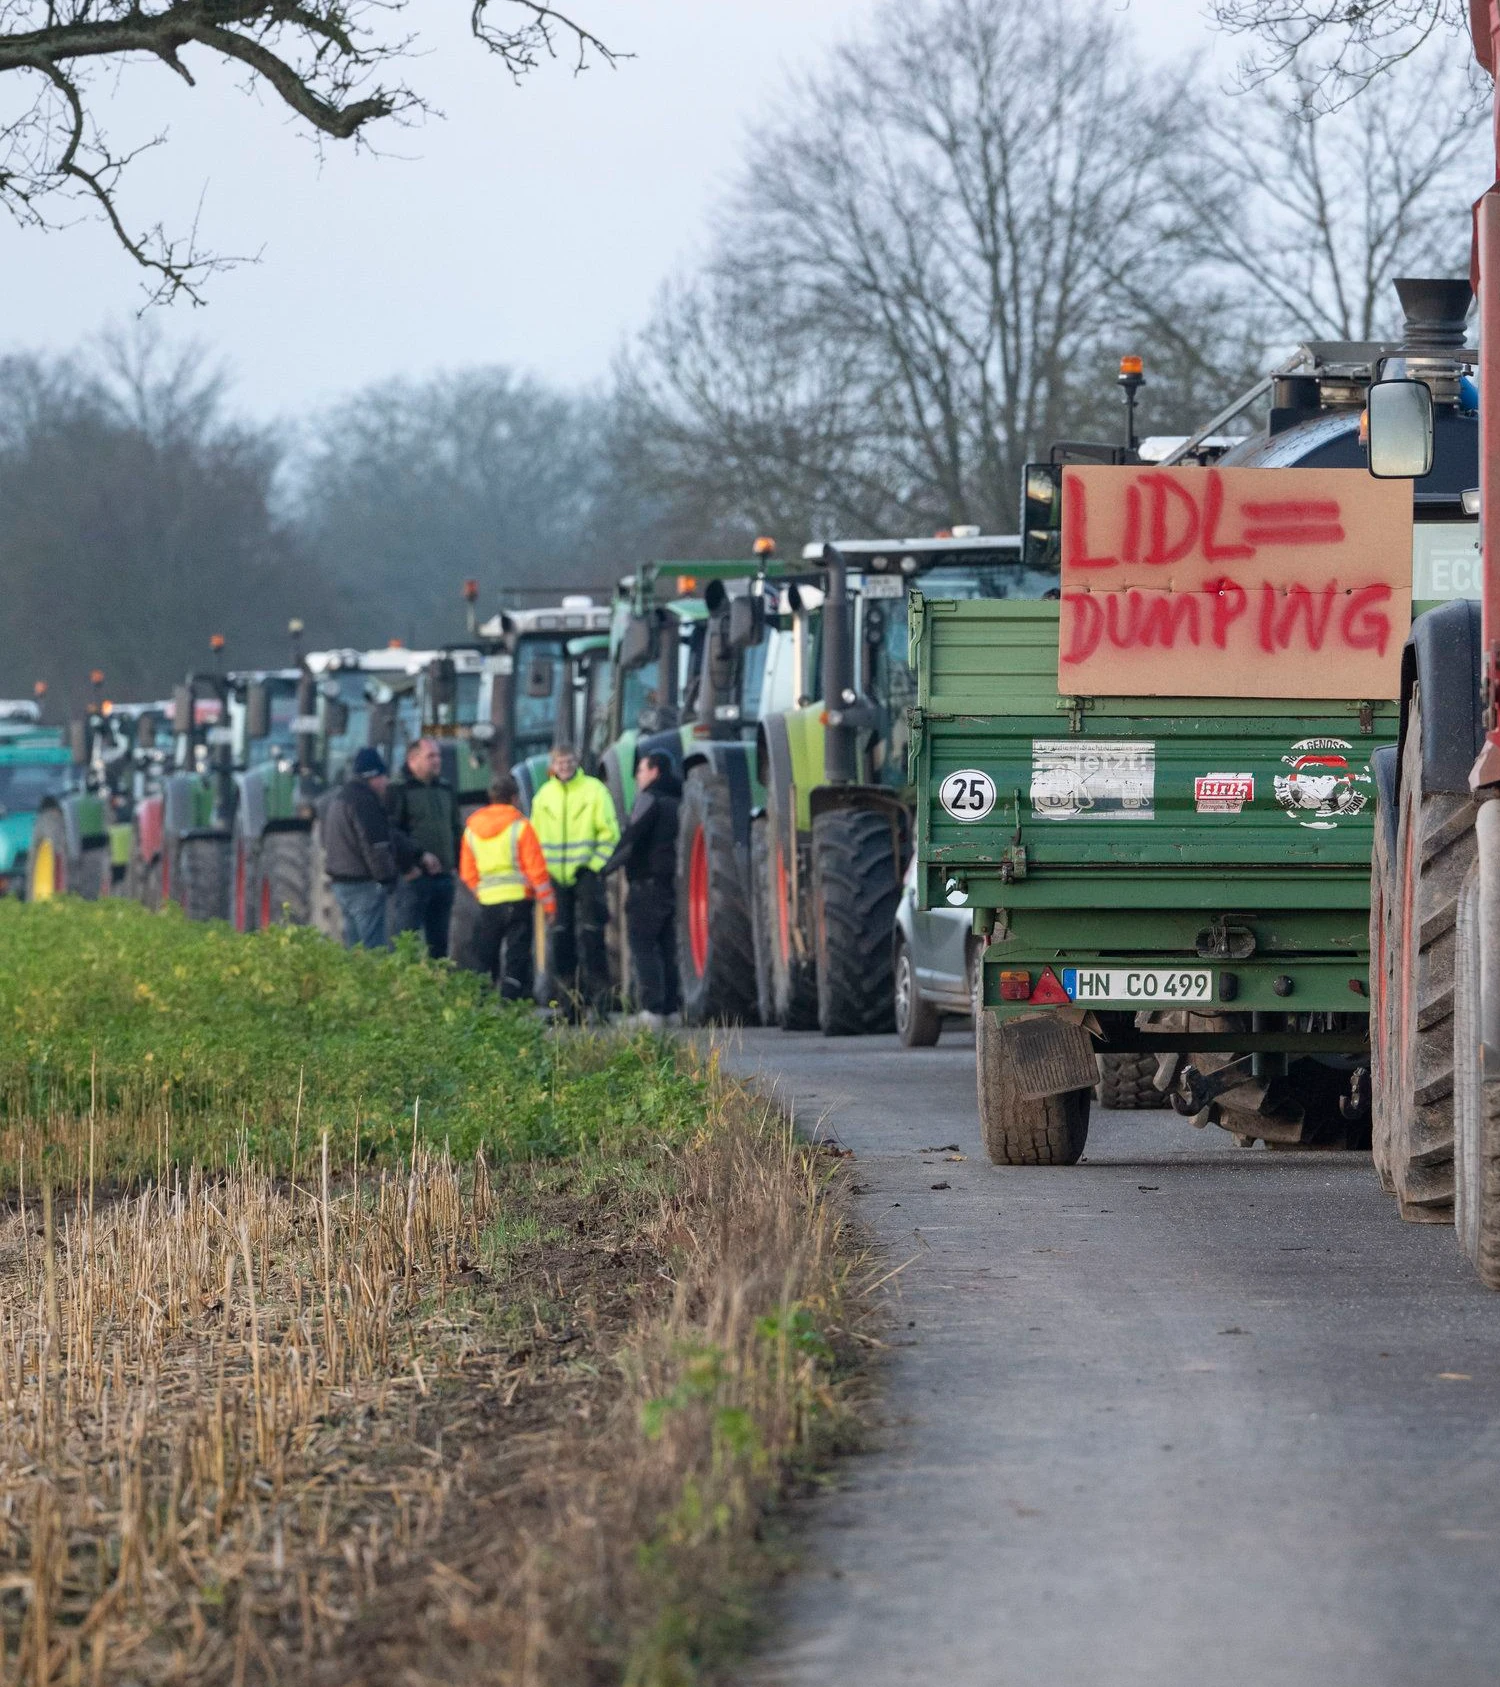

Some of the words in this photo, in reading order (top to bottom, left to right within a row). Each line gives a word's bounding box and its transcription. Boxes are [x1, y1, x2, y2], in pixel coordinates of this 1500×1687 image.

[1061, 577, 1392, 665] DUMPING
[951, 778, 985, 811] 25
[1078, 972, 1111, 997] HN
[1126, 973, 1159, 997] CO
[1163, 973, 1208, 997] 499
